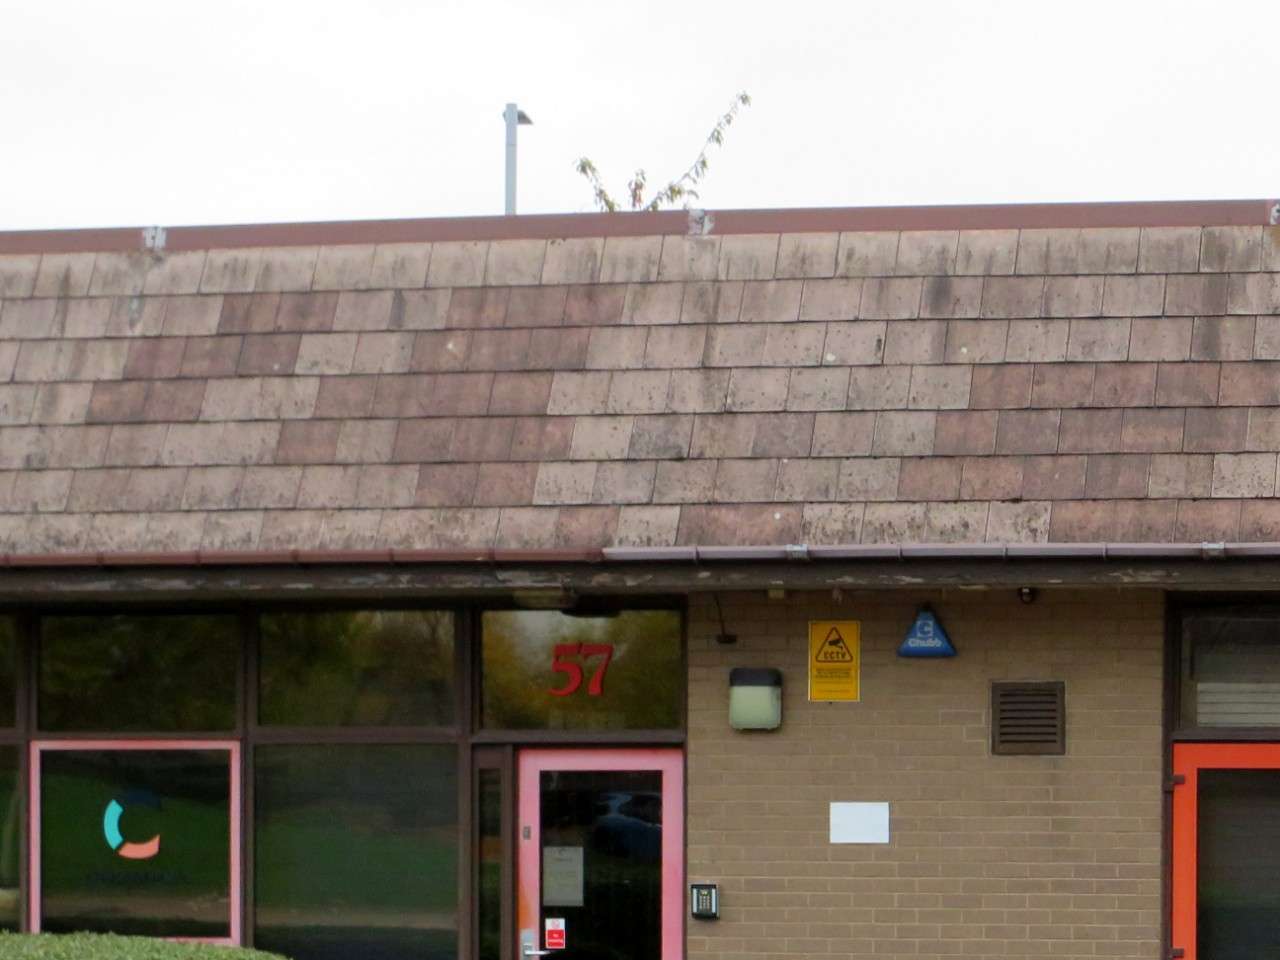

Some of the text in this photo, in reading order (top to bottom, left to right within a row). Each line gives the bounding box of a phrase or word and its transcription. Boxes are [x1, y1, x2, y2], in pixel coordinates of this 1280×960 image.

[908, 638, 943, 648] Chubb
[823, 651, 847, 660] CCTV
[548, 643, 613, 697] 57
